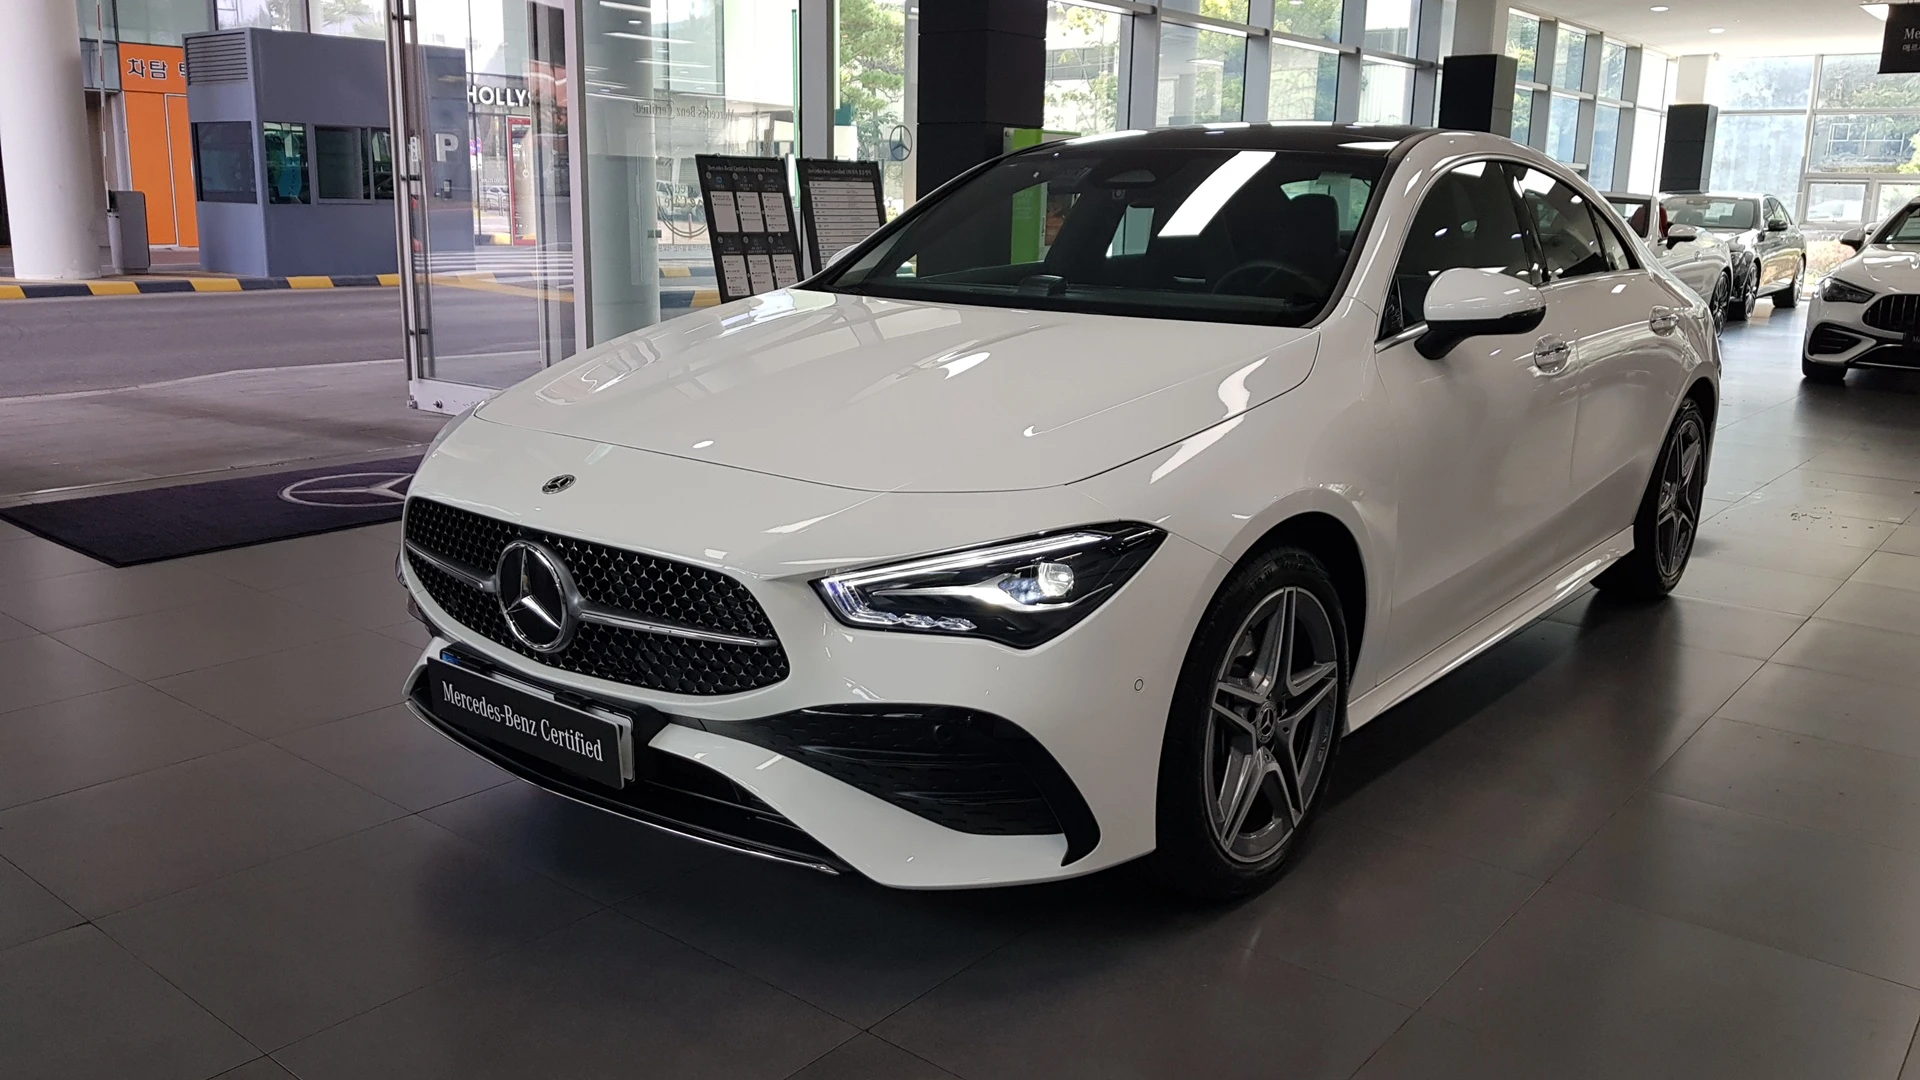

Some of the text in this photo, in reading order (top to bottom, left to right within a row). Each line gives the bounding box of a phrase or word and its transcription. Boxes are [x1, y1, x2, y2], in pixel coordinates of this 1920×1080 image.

[1902, 43, 1920, 52] 메르
[127, 58, 168, 80] 차탐
[467, 85, 530, 107] HOLLY
[435, 133, 459, 162] P
[441, 680, 604, 762] Mercedes-Benz Certified
